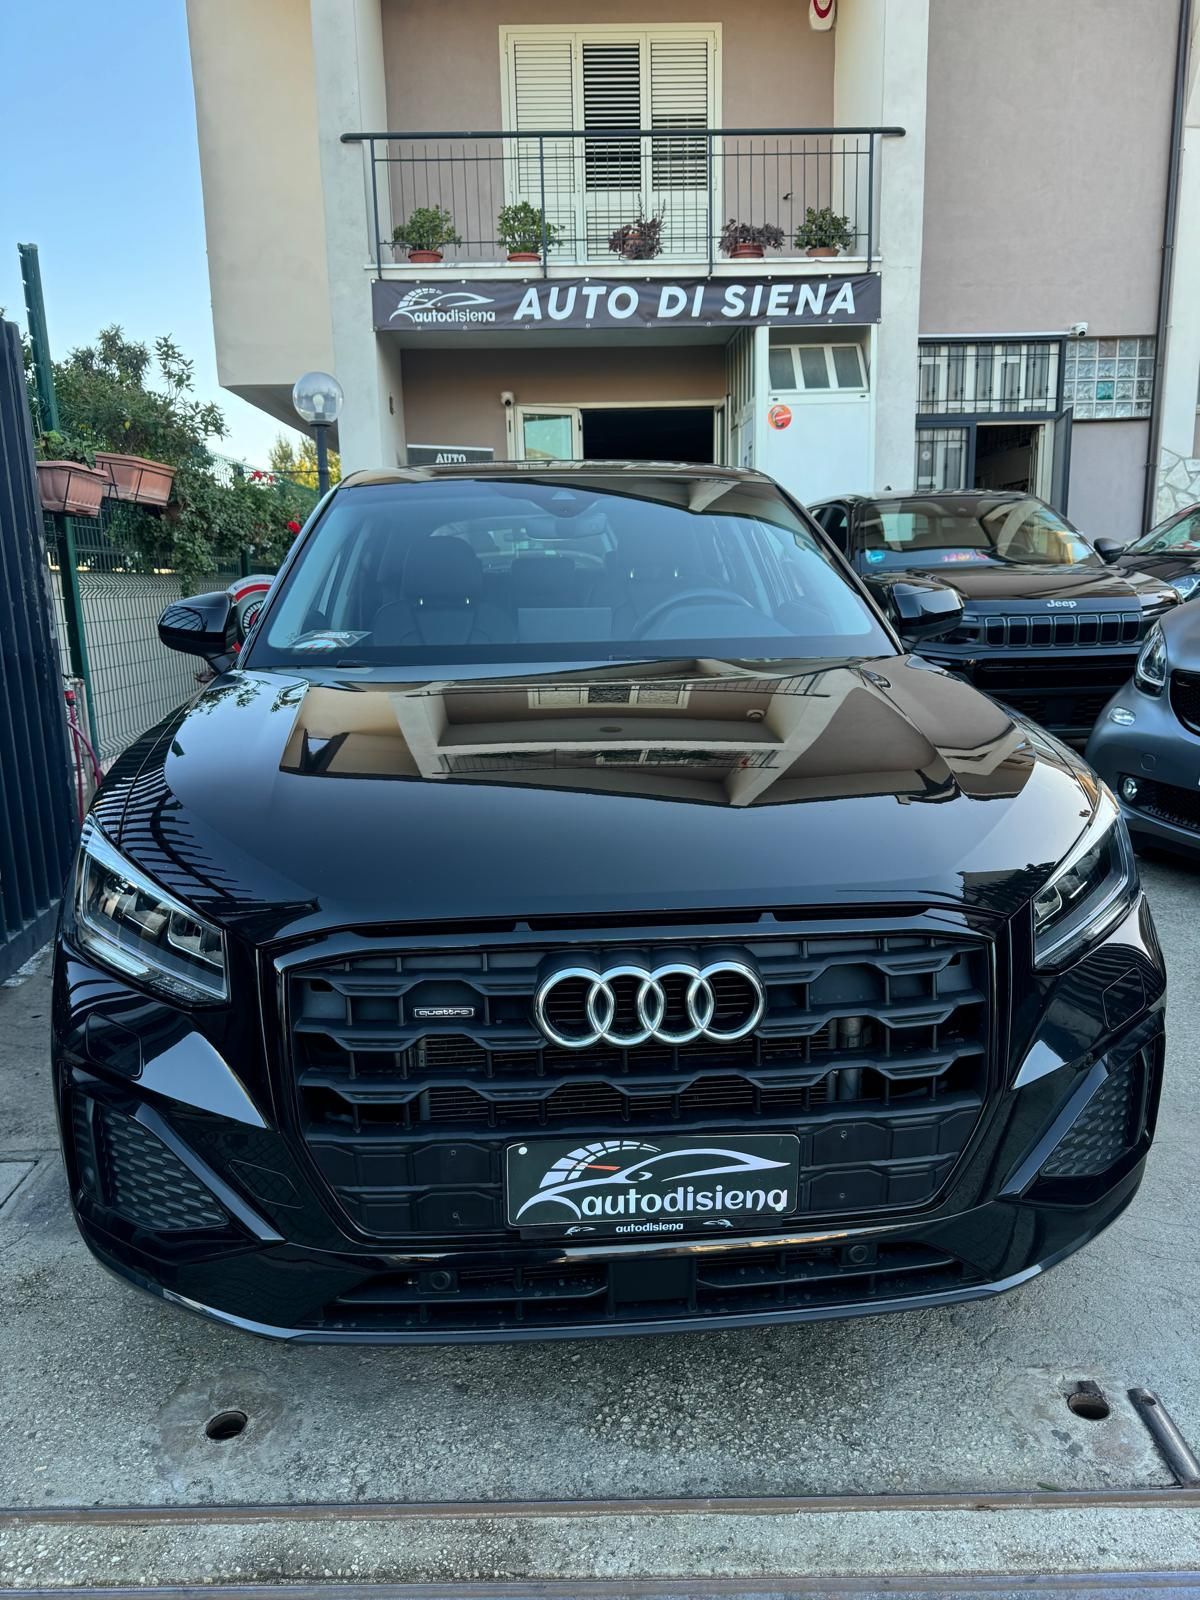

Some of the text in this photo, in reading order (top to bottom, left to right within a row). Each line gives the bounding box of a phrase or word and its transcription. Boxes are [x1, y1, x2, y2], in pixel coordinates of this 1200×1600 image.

[512, 282, 856, 321] AUTO DI SIENA
[414, 308, 496, 324] autodisiena
[435, 453, 467, 464] AUTO
[1046, 599, 1077, 609] Jeep
[418, 1009, 470, 1017] quattro
[581, 1185, 788, 1216] autodisiena
[615, 1221, 684, 1233] autodisiena
